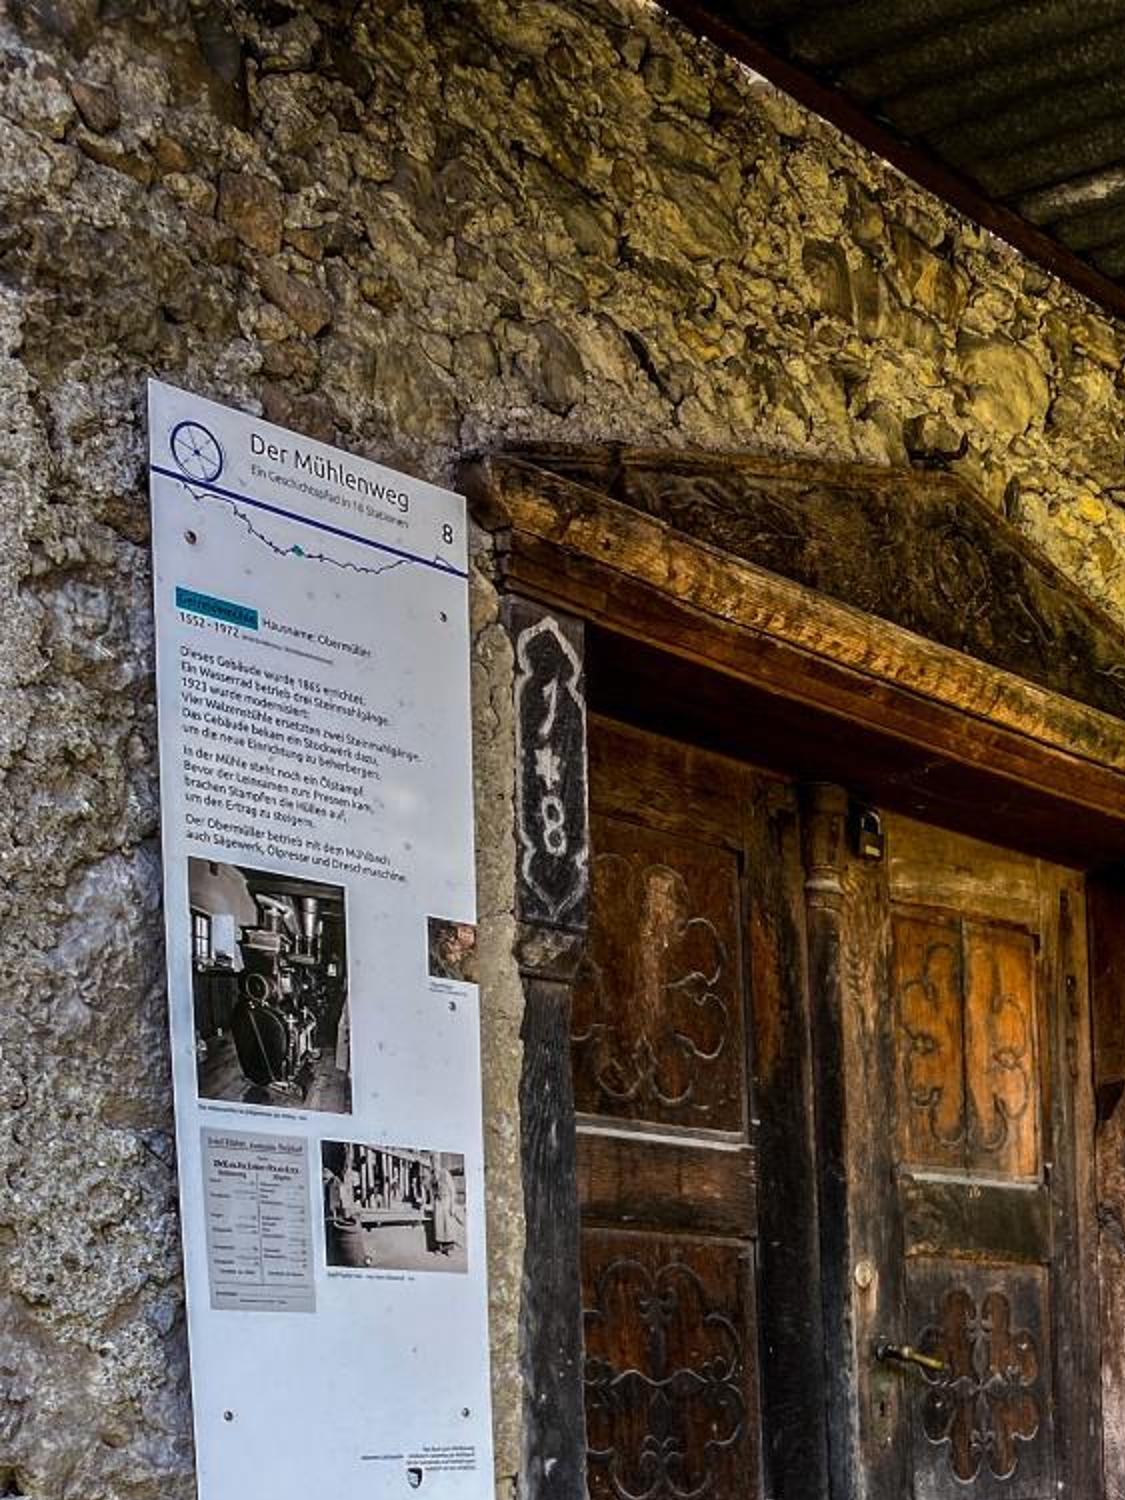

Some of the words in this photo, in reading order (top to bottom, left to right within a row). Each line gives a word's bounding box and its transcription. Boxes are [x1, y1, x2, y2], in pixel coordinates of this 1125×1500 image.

[250, 463, 266, 479] Ein
[250, 433, 288, 465] Der
[294, 448, 409, 514] Mühlenweg
[441, 523, 452, 545] 8
[179, 612, 204, 628] 1552
[213, 621, 239, 638] 1972
[180, 645, 214, 664] Dieses
[217, 654, 260, 677] Gebäude
[263, 667, 294, 685] wurde
[181, 661, 197, 675] Ein
[199, 665, 252, 689] Wasserrad
[254, 680, 290, 699] betrieb
[182, 676, 206, 691] 1923
[209, 683, 242, 701] wurde
[538, 676, 558, 737] 1
[181, 692, 202, 706] Vier
[205, 698, 272, 723] Walzenstühle
[275, 716, 320, 736] ersetzten
[323, 729, 344, 742] zwei
[182, 707, 201, 721] Das
[203, 712, 248, 733] Gebäude
[251, 724, 283, 741] bekam
[286, 733, 301, 746] ein
[303, 737, 352, 758] Stockwerk
[183, 725, 199, 736] um
[201, 726, 217, 740] die
[220, 733, 245, 747] neue
[248, 739, 302, 763] Einrichtung
[305, 754, 316, 764] zu
[183, 745, 192, 756] In
[195, 747, 212, 761] der
[215, 752, 247, 769] Mühle
[249, 760, 274, 775] steht
[277, 767, 300, 781] noch
[303, 773, 317, 785] ein
[183, 759, 213, 776] Bevor
[218, 767, 233, 780] der
[313, 789, 349, 807] Pressen
[184, 775, 225, 793] brachen
[228, 784, 276, 805] Stampfen
[279, 796, 294, 808] die
[185, 793, 200, 803] um
[204, 794, 222, 808] den
[225, 799, 256, 817] Ertrag
[259, 809, 270, 818] zu
[186, 813, 202, 826] Der
[207, 816, 264, 839] Obermüller
[267, 830, 302, 846] betrieb
[305, 838, 320, 850] mit
[324, 841, 343, 855] dem
[542, 796, 566, 856] 8
[186, 828, 209, 842] auch
[267, 843, 309, 864] Ölpresse
[312, 854, 329, 866] und
